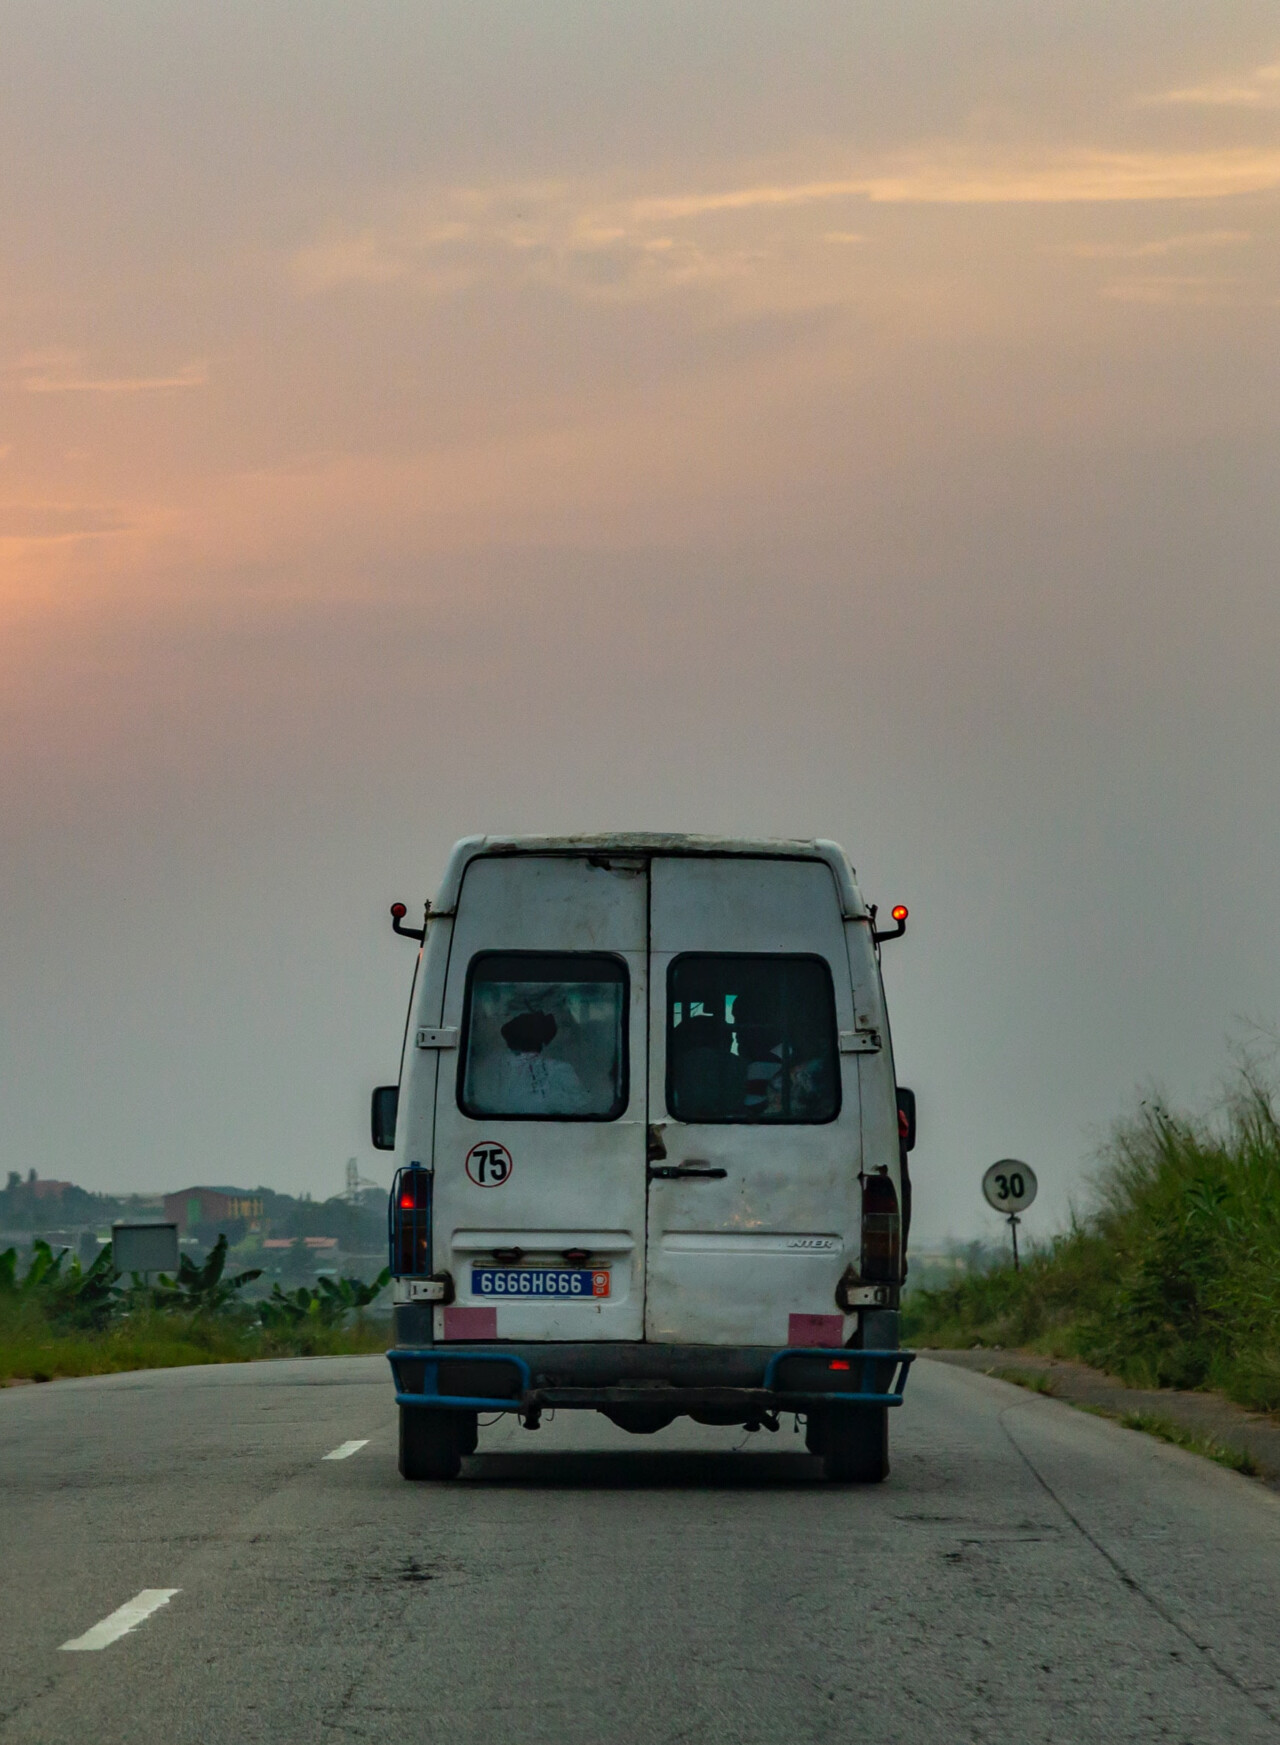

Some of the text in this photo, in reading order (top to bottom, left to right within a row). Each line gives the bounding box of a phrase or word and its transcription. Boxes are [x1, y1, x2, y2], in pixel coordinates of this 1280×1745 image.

[472, 1148, 507, 1183] 75
[995, 1172, 1024, 1200] 30
[481, 1273, 582, 1293] 6666H666
